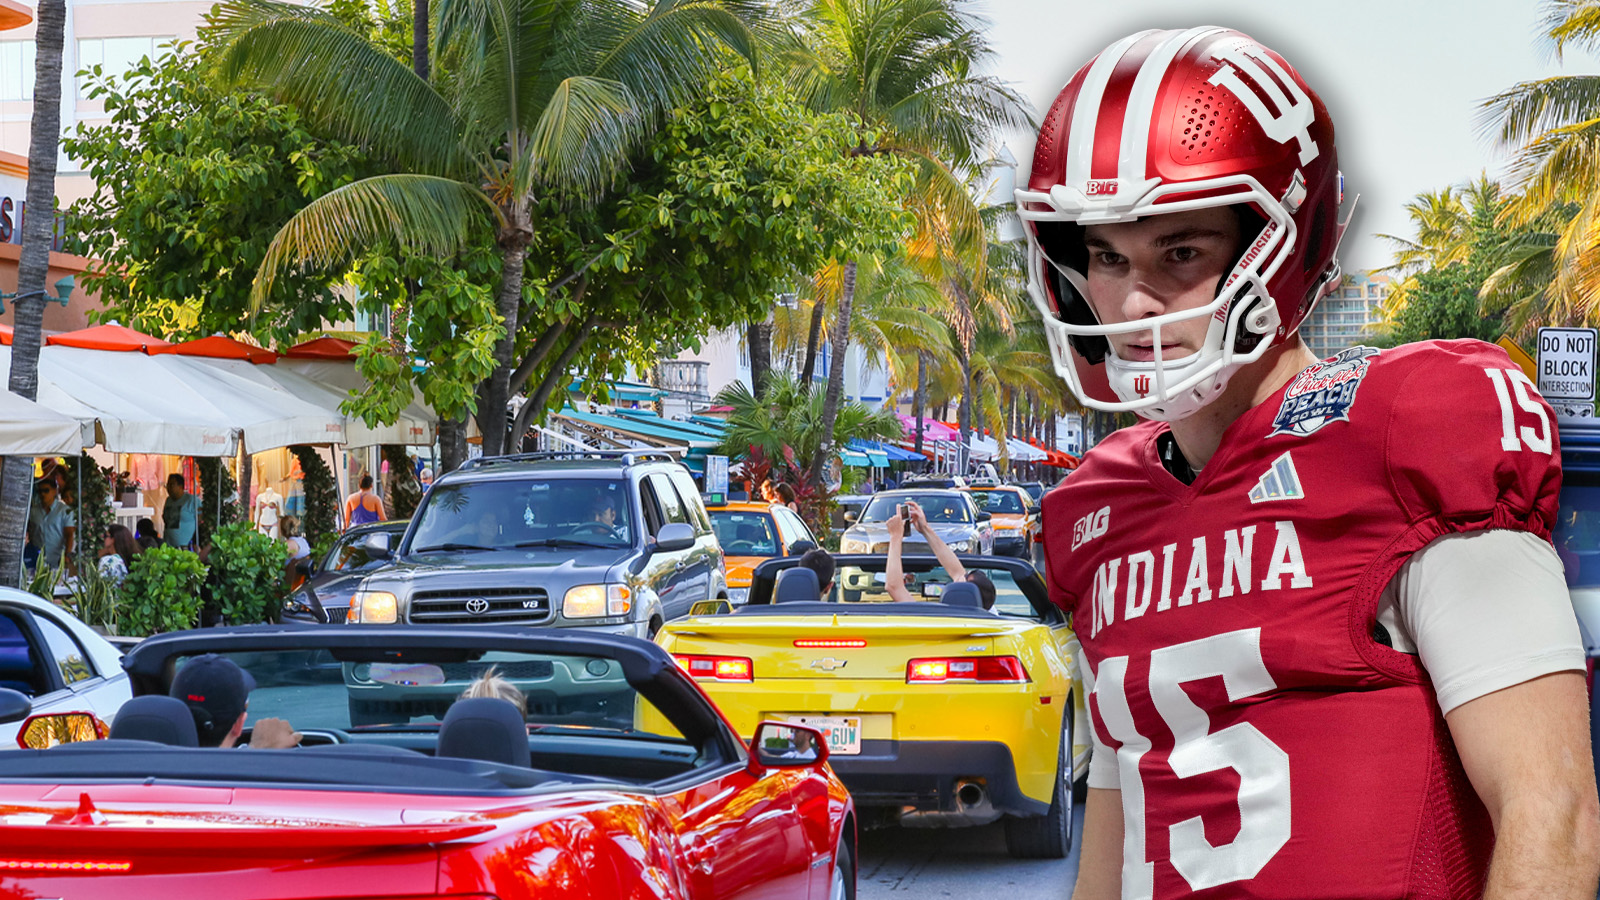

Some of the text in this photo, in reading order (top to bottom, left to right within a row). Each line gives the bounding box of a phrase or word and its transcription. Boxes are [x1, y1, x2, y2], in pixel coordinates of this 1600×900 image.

[1542, 336, 1592, 353] DO NOT
[1544, 360, 1588, 377] BLOCK
[1541, 380, 1591, 393] INTERSECTION
[1276, 381, 1357, 424] PEACH
[1483, 367, 1553, 456] 15
[1290, 405, 1335, 424] BOWL
[1090, 520, 1314, 640] INDIANA
[522, 600, 539, 610] V8
[1093, 626, 1292, 900] 15
